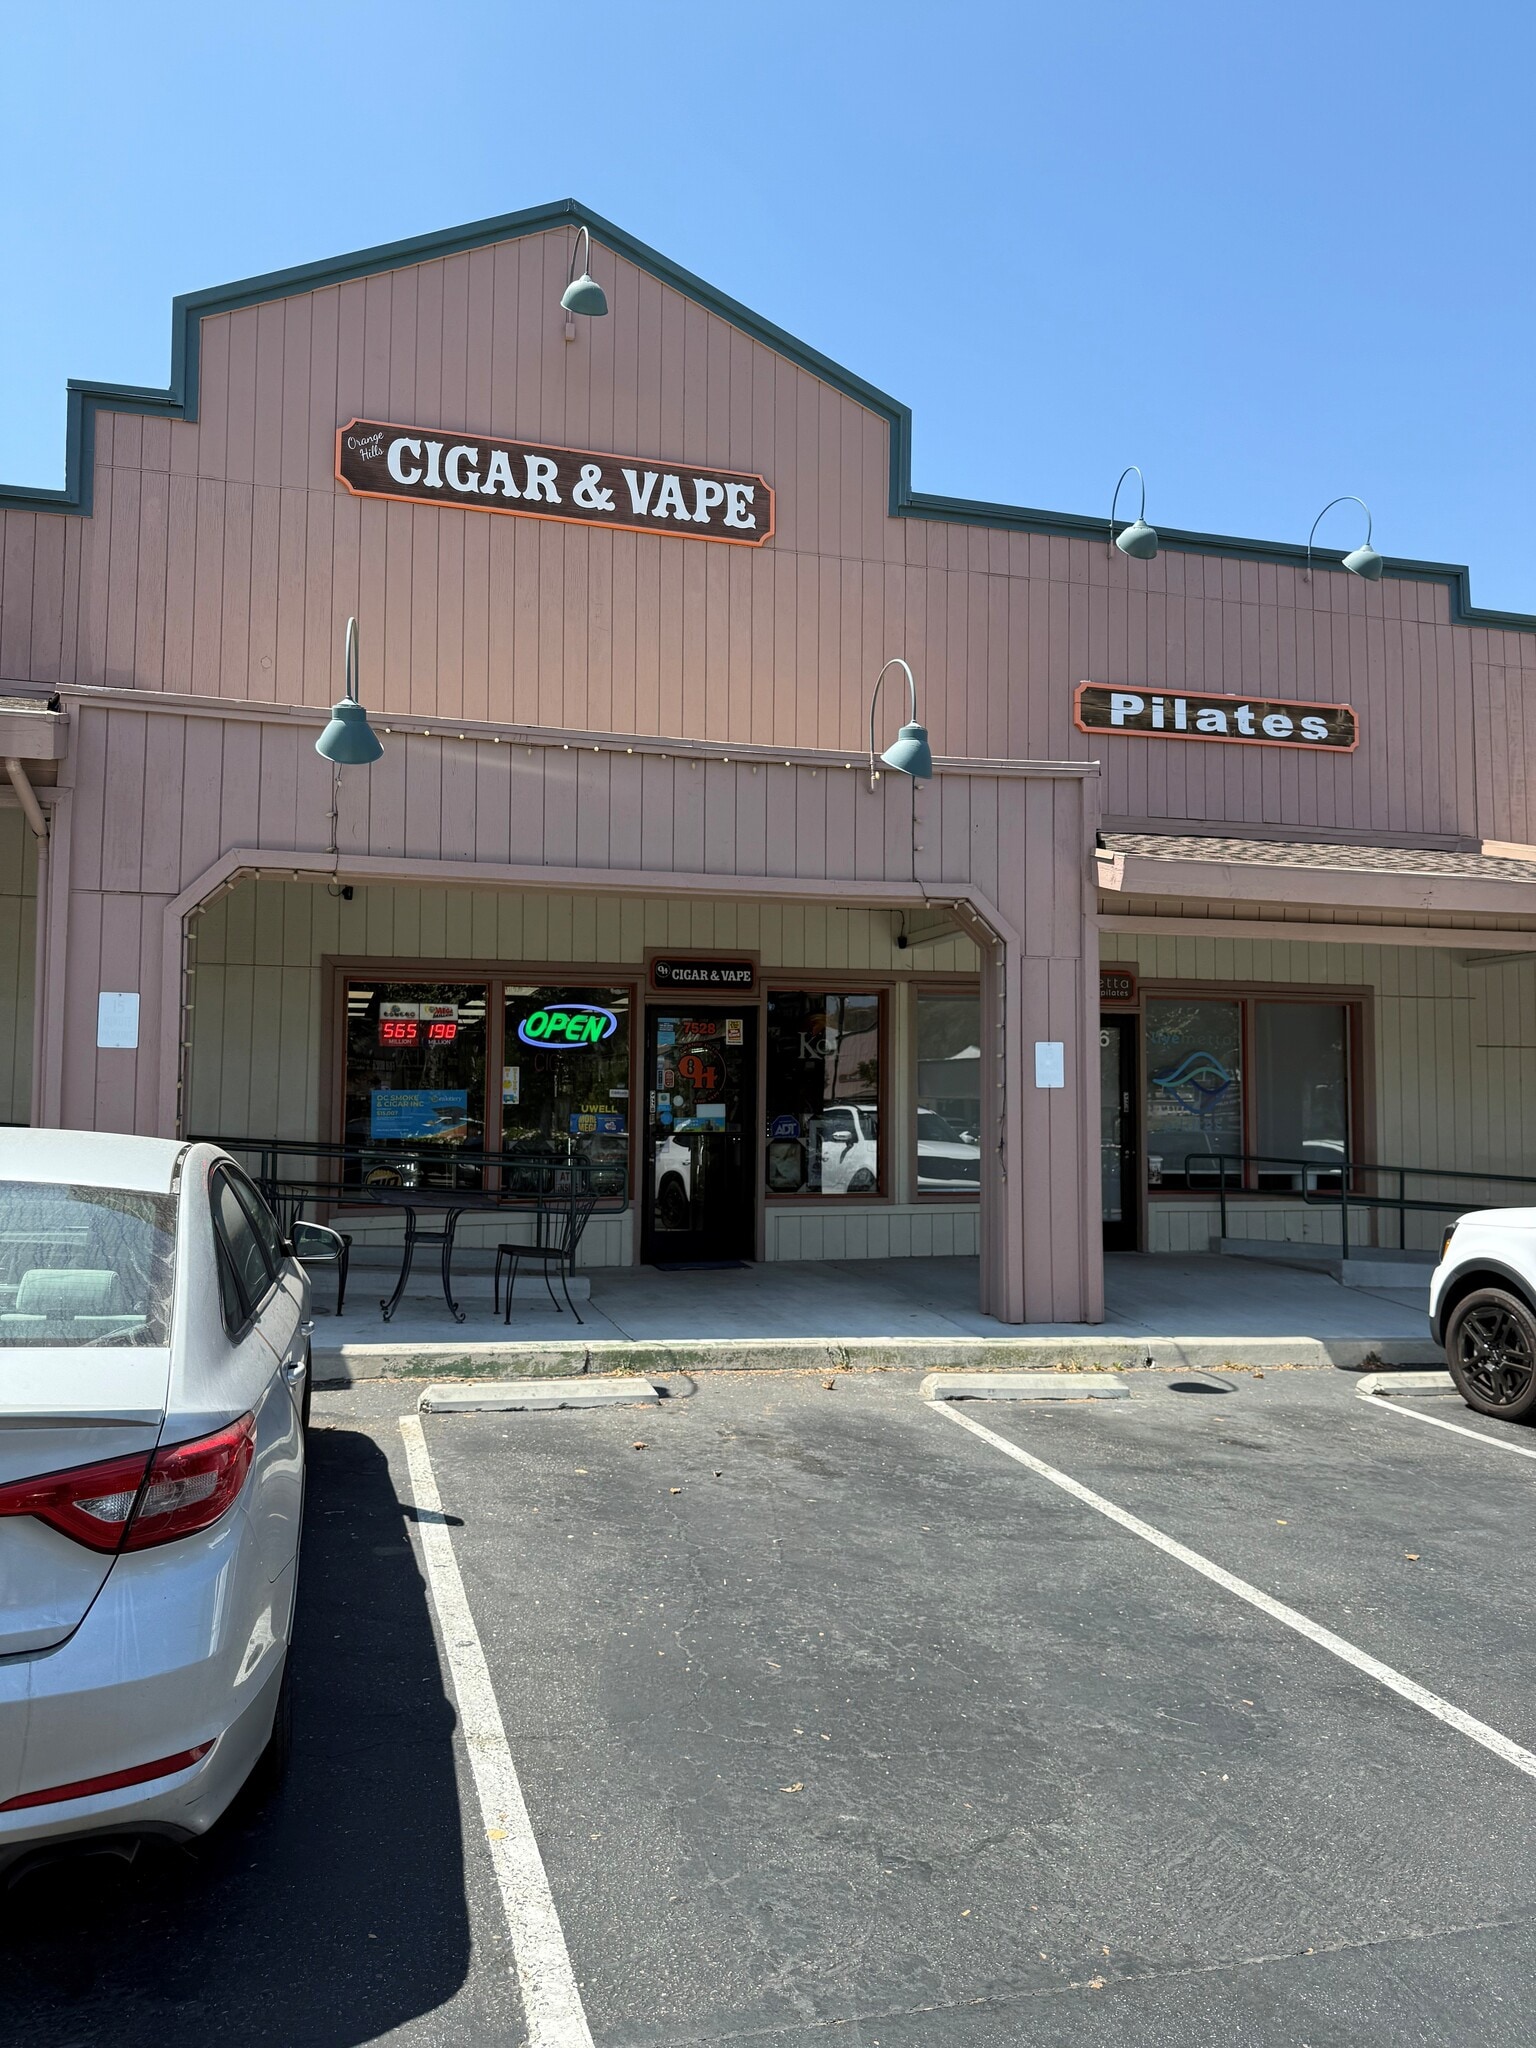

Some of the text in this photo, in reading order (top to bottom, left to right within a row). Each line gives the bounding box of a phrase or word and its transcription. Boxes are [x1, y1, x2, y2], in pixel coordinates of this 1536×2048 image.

[347, 432, 384, 450] Orange
[360, 445, 384, 462] Hills
[386, 437, 757, 530] CIGAR & VAPE
[1110, 693, 1329, 740] Pilates
[671, 968, 710, 981] CIGAR
[710, 969, 720, 982] &
[720, 970, 752, 982] VAPE
[1100, 990, 1129, 998] pilates
[383, 1023, 457, 1039] 565 198
[525, 1010, 608, 1043] OPEN
[684, 1021, 716, 1035] 7528
[581, 1104, 618, 1113] UWELL
[578, 1114, 597, 1123] MORE
[578, 1123, 597, 1133] MEGA
[774, 1123, 798, 1136] ADT
